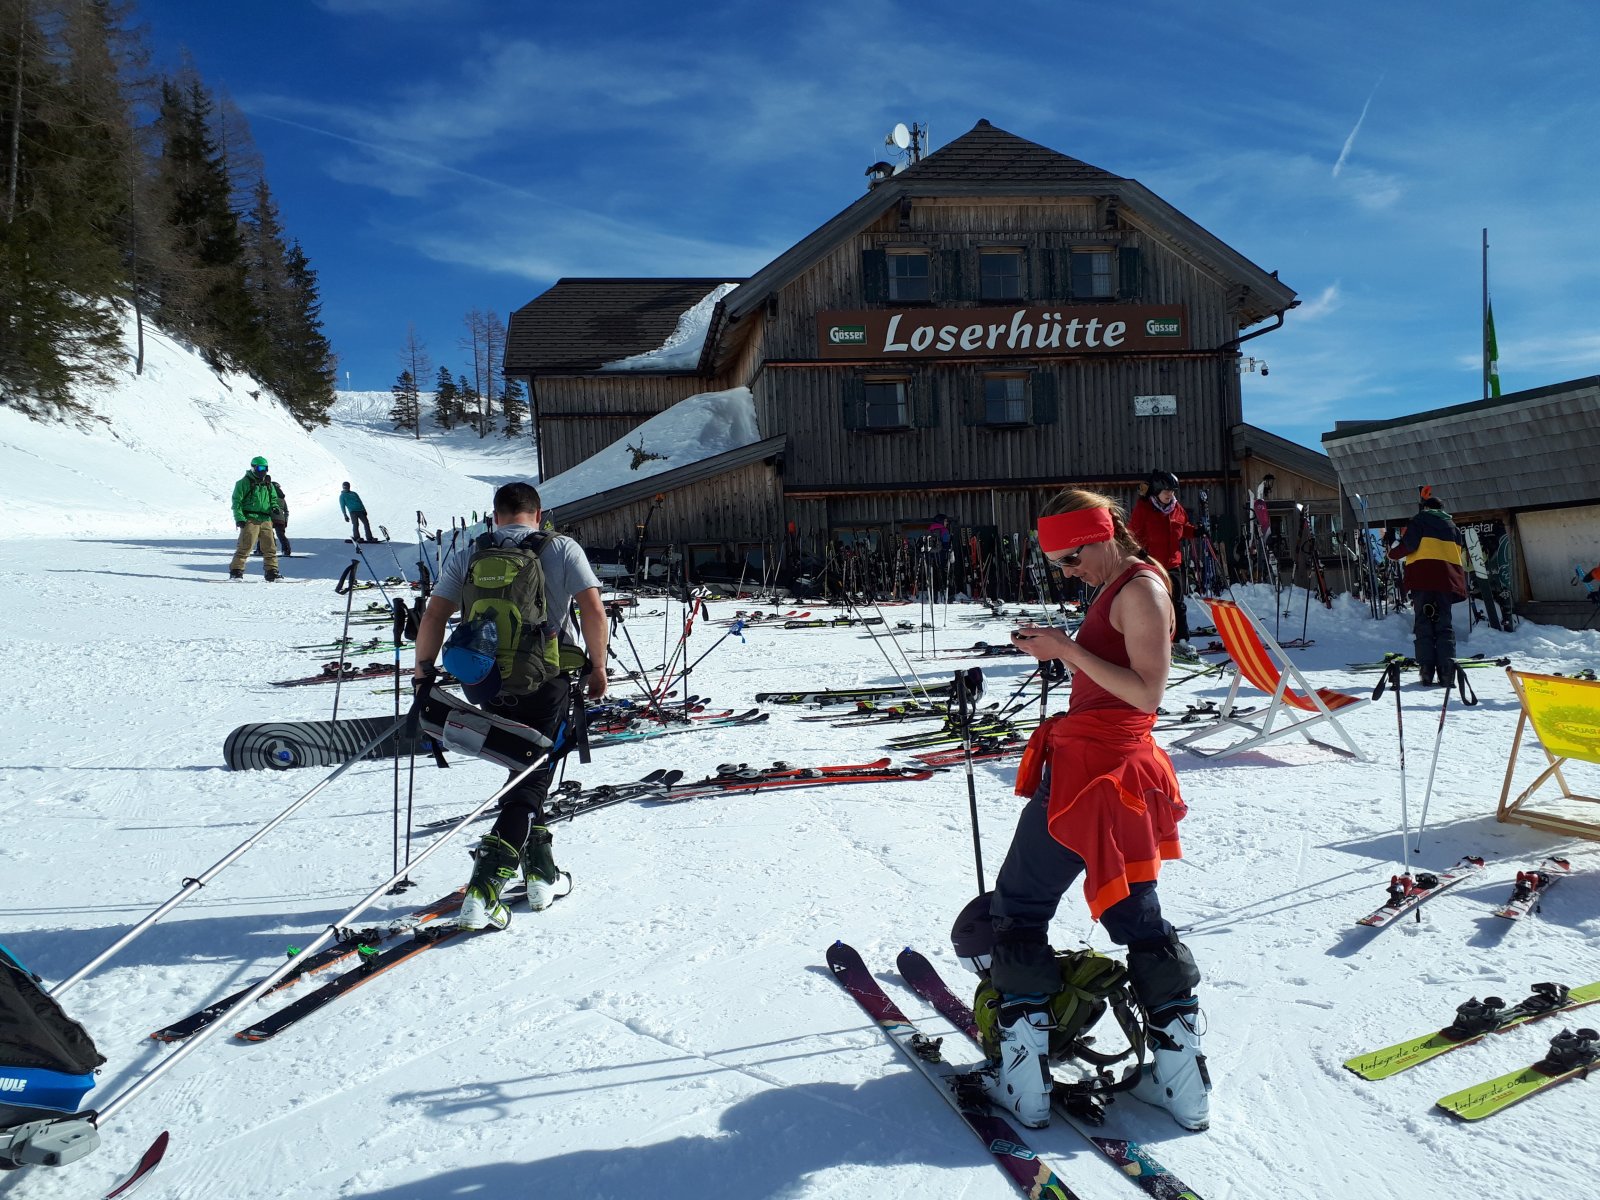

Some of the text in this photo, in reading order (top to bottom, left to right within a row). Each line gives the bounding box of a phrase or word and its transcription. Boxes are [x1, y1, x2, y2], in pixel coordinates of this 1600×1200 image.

[829, 326, 864, 343] Gösser
[883, 309, 1126, 352] Loserhütte
[1146, 319, 1178, 335] Gösser
